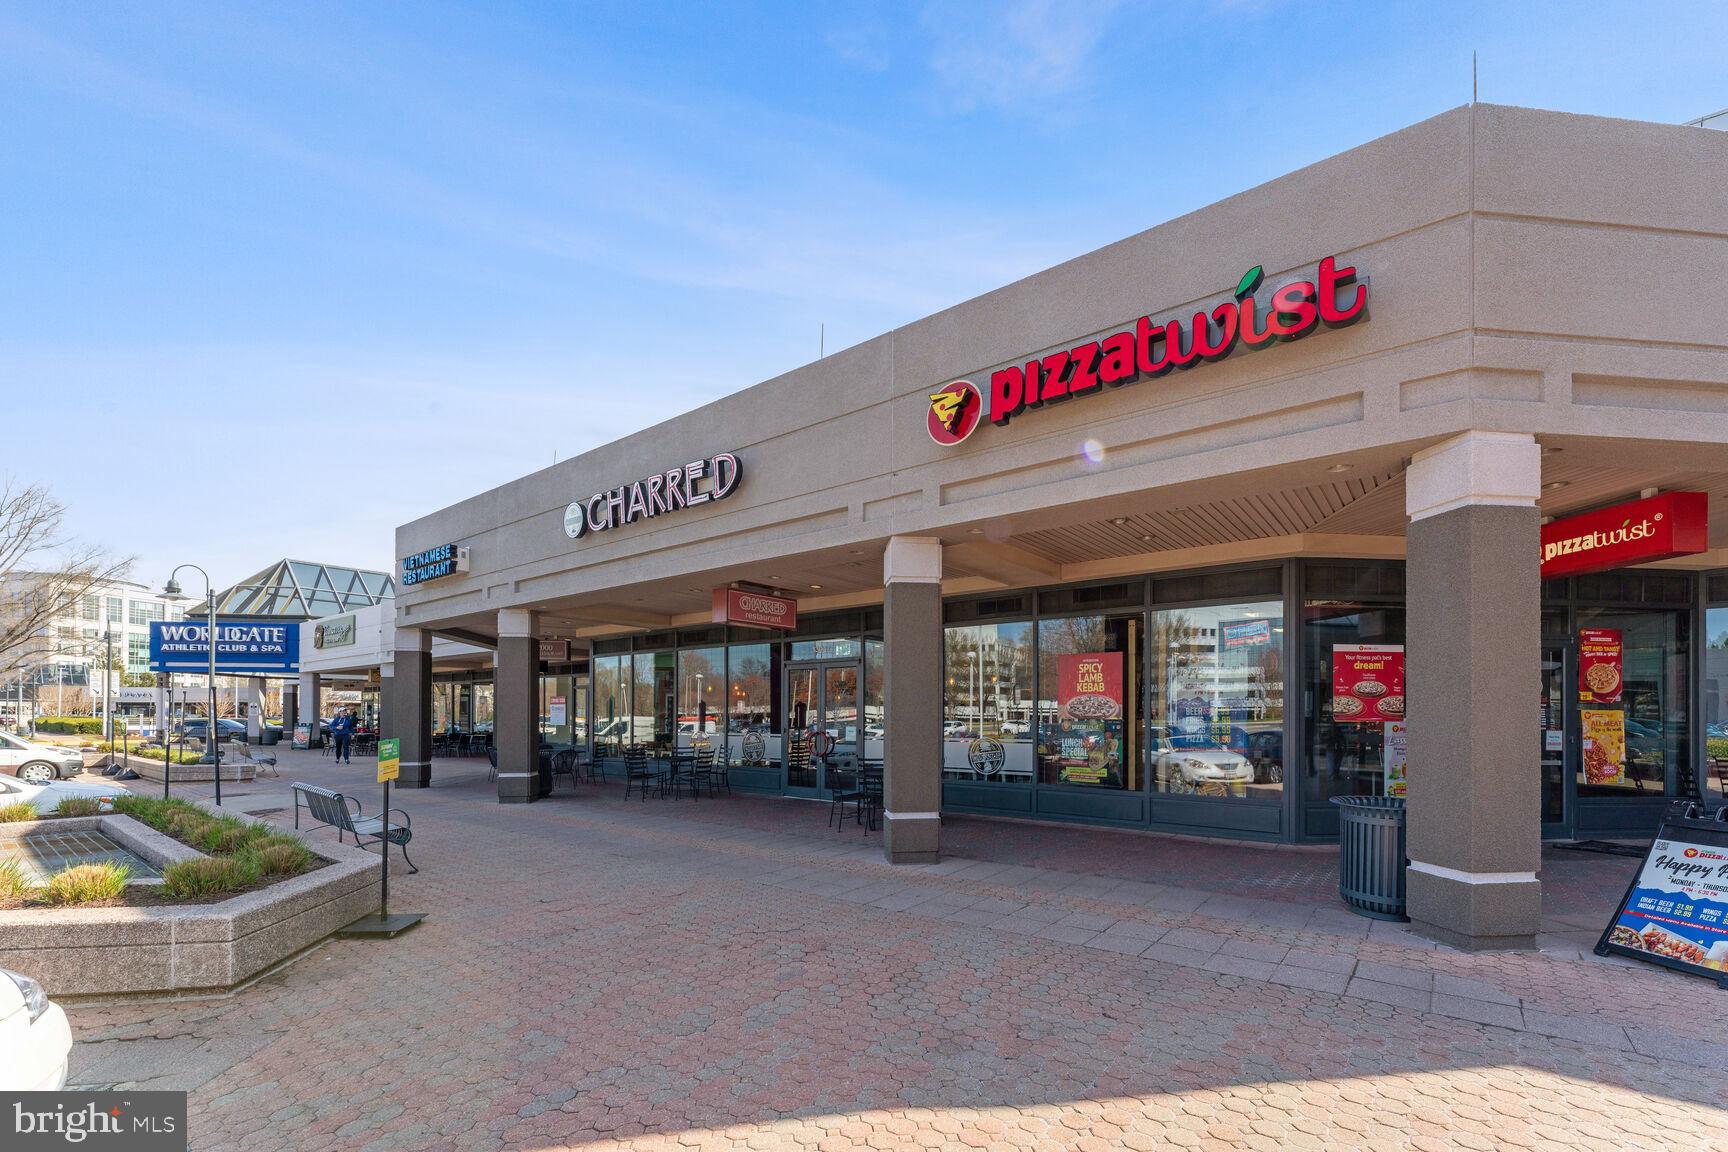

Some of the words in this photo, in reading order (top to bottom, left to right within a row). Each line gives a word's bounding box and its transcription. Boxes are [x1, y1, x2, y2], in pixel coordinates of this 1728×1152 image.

[990, 255, 1367, 424] pizzatwist
[587, 453, 740, 531] CHARRED
[1545, 519, 1655, 560] pizzatwist
[402, 543, 453, 571] VIETNAMESE
[402, 560, 453, 585] RESTAURANT
[739, 596, 787, 615] CHARRED
[745, 612, 781, 623] restaurant
[160, 625, 284, 642] WORLDGATE
[218, 644, 247, 652] CLUB
[250, 644, 259, 652] &
[261, 644, 282, 652] SPA
[1078, 663, 1104, 673] SPICY
[1353, 661, 1384, 670] dream!
[1078, 673, 1104, 682] LAMB
[1076, 683, 1105, 692] KEBAB
[1185, 707, 1203, 715] BEER
[1061, 738, 1083, 748] LUNCH
[1185, 734, 1204, 742] PIZZA
[1061, 748, 1089, 757] SPECIAL
[1655, 855, 1714, 879] Happy
[1670, 878, 1696, 888] MONDAY
[1640, 896, 1658, 904] DRAFT
[1658, 900, 1675, 908] BEER
[1637, 902, 1656, 910] INDIAN
[1655, 906, 1672, 914] BEER
[1673, 909, 1692, 918] $2.99
[1702, 908, 1723, 917] WINGS
[1699, 914, 1718, 922] PIZZA
